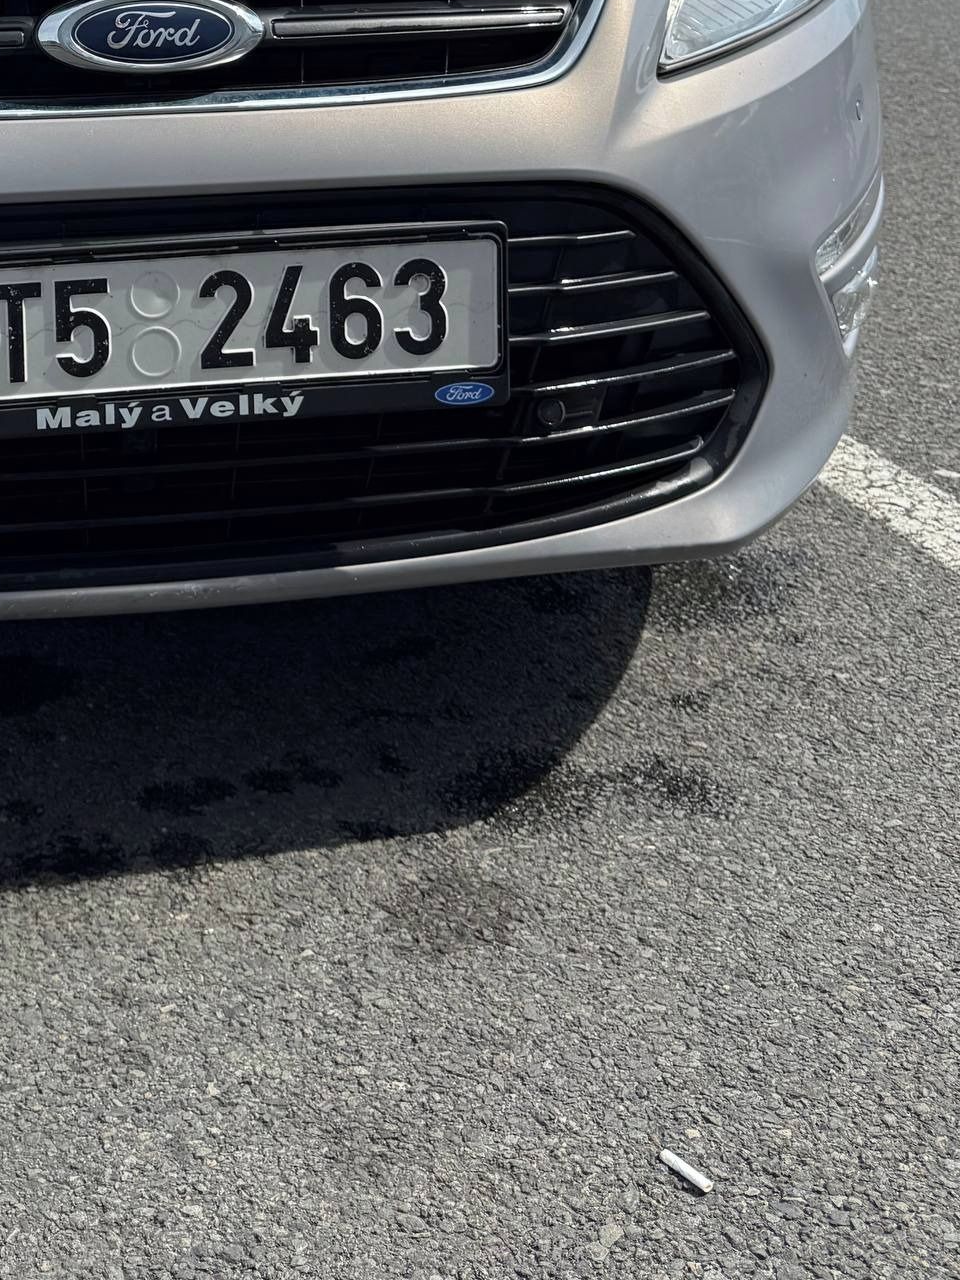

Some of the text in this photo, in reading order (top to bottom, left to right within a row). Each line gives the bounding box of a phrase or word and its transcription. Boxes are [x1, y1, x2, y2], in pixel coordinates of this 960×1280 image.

[106, 10, 201, 50] Ford
[198, 257, 448, 371] 2463
[35, 390, 305, 430] Malý a Velký
[445, 385, 483, 401] Ford
